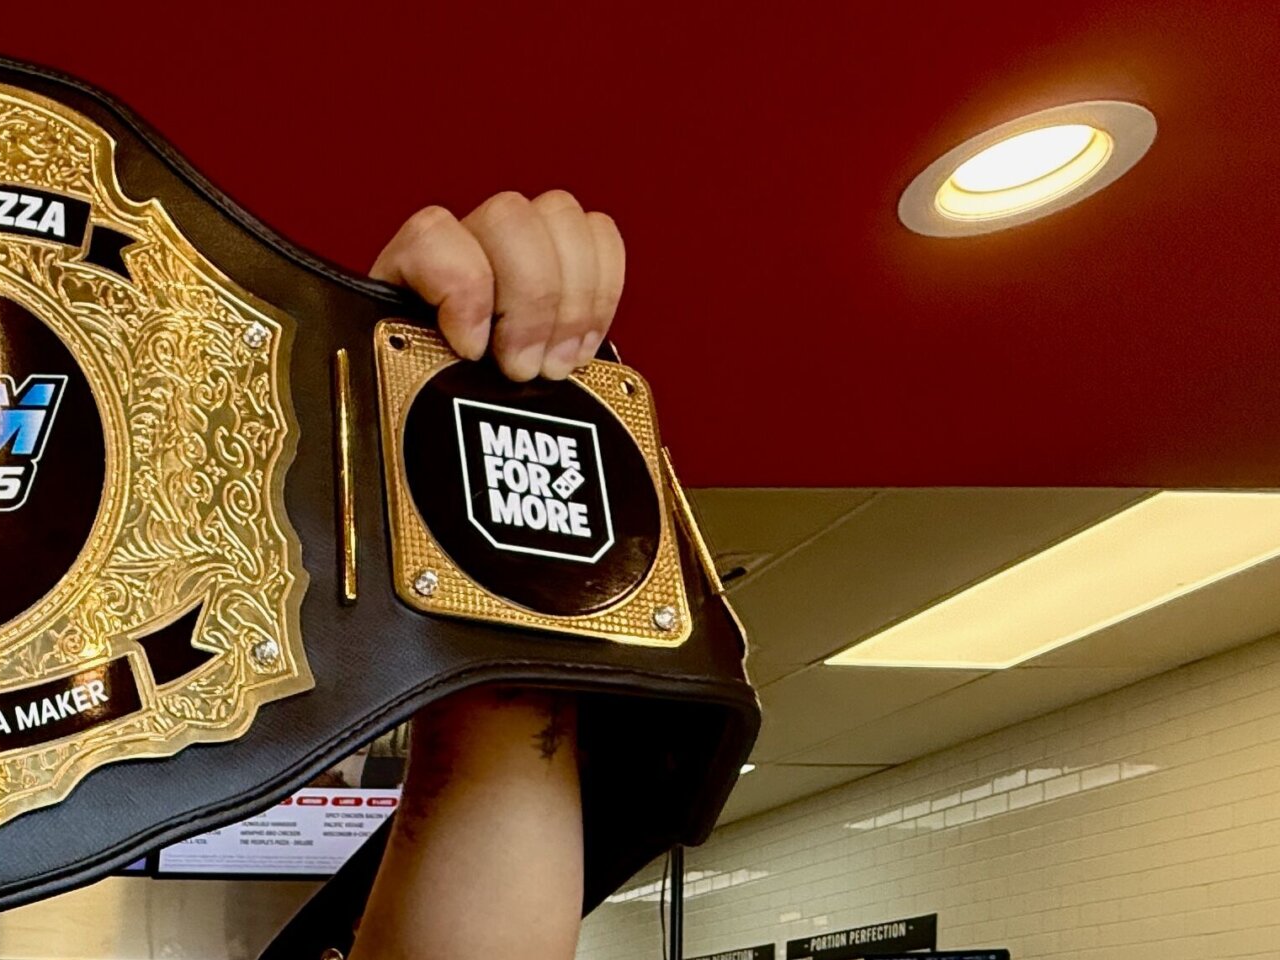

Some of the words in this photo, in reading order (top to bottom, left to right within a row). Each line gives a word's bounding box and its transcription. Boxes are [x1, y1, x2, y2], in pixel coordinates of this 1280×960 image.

[478, 421, 580, 470] MADE
[484, 454, 553, 498] FOR
[488, 488, 591, 538] MORE
[14, 680, 108, 730] MAKER
[810, 932, 847, 952] PORTION
[848, 922, 907, 945] PERFECTION
